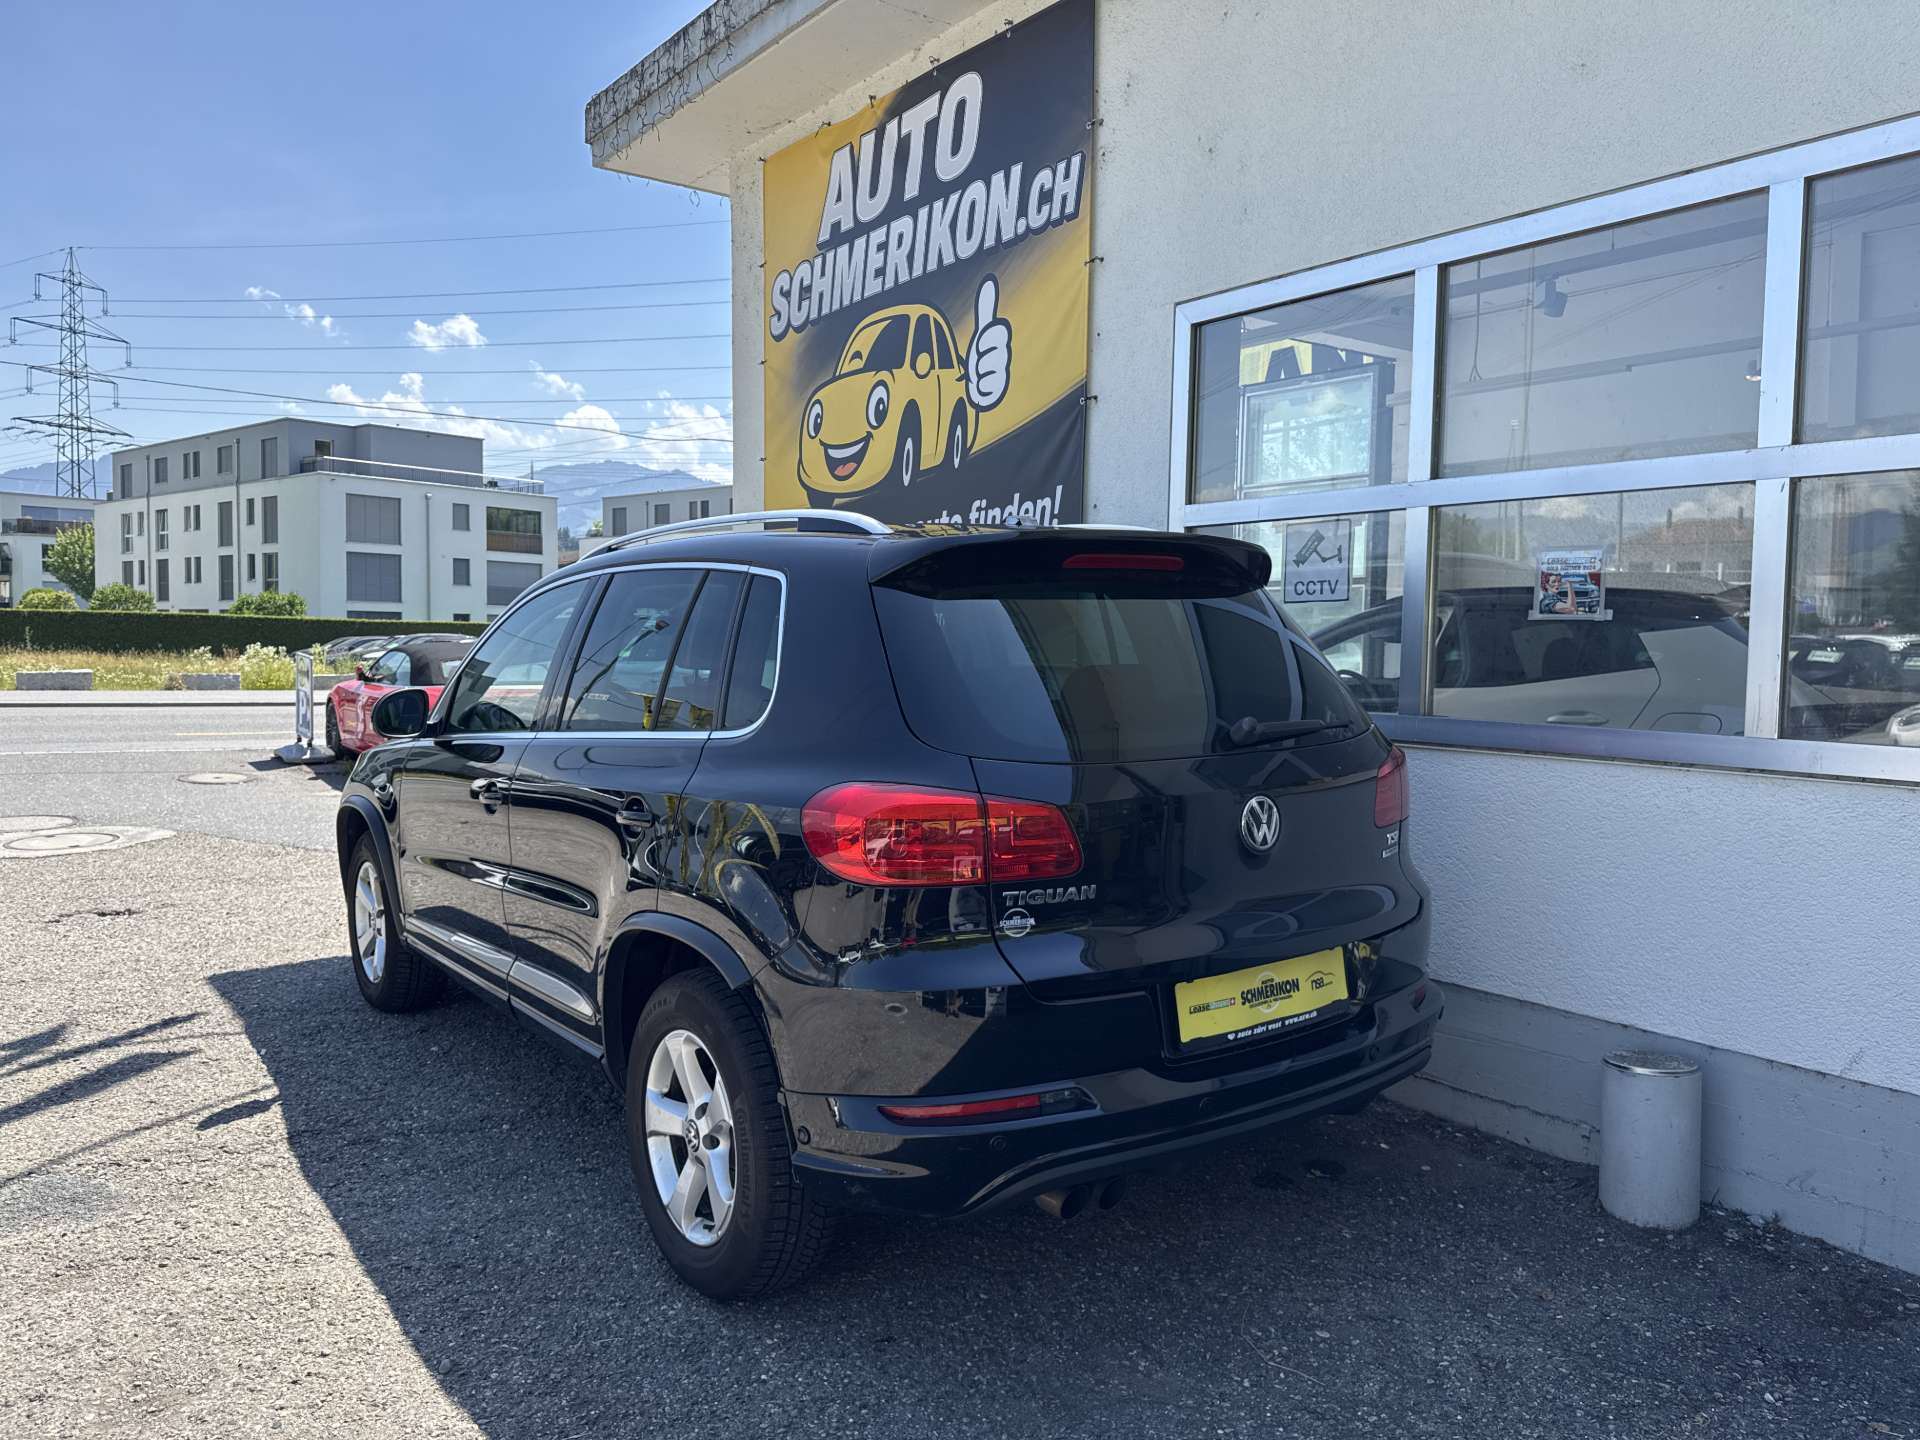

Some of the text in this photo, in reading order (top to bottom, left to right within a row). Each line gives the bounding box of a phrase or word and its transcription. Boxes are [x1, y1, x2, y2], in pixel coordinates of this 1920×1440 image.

[817, 71, 982, 246] AUTO
[769, 152, 1086, 339] SCHMERIKON.CH
[1294, 579, 1339, 596] CCTV
[1002, 884, 1096, 906] TIGUAN
[1241, 978, 1300, 1005] SCHMERIKON
